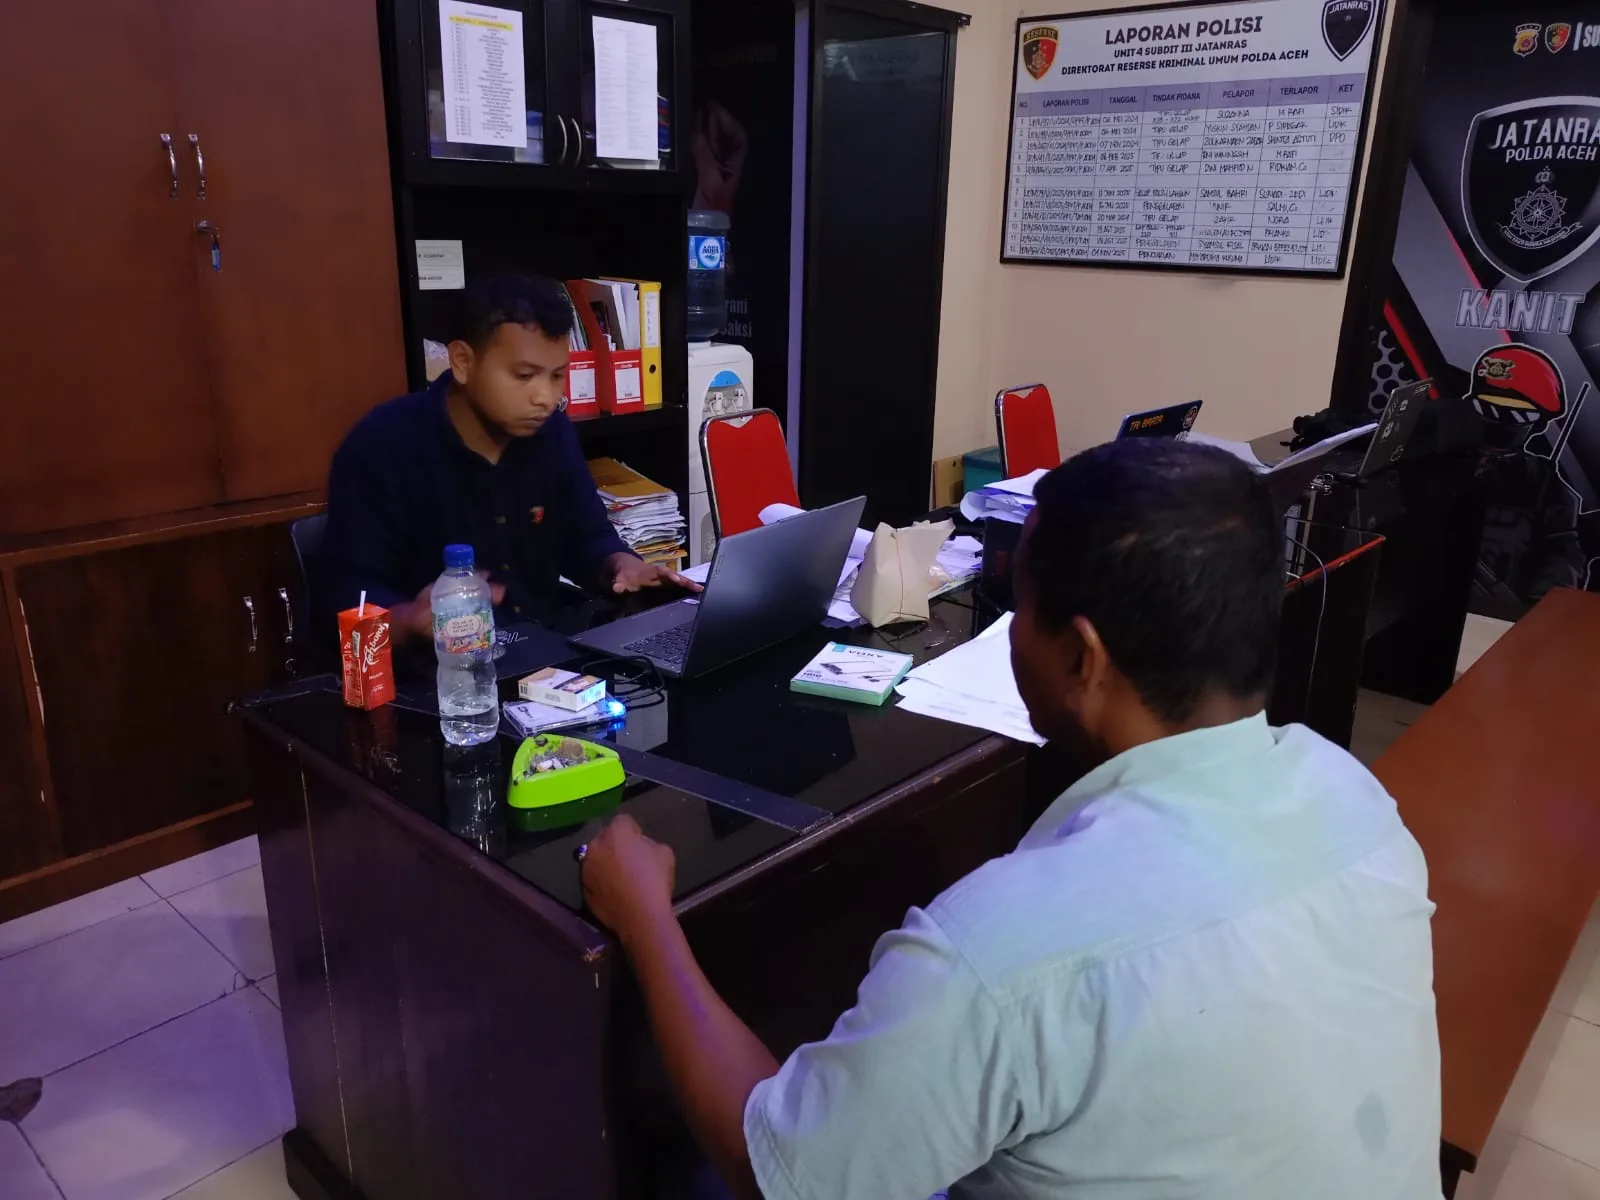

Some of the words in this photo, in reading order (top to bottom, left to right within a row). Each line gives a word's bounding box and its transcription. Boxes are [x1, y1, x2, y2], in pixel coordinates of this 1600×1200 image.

[1329, 0, 1368, 13] JATANRAS
[1105, 22, 1191, 45] LAPORAN
[1196, 16, 1263, 37] POLISI
[1145, 46, 1179, 56] SUBDIT
[1181, 44, 1193, 53] III
[1195, 39, 1247, 51] JATANRAS
[1061, 63, 1115, 76] DIREKTORAT
[1117, 61, 1156, 72] RESERSE
[1158, 57, 1206, 69] KRIMINAL
[1208, 55, 1239, 65] UMUM
[1241, 52, 1277, 63] POLDA
[1279, 49, 1309, 61] ACEH
[1223, 89, 1254, 98] PELAPOR
[1280, 86, 1318, 95] TERLAPOR
[1338, 84, 1354, 92] KET
[1109, 96, 1137, 104] TANGGAL
[1152, 93, 1175, 102] TINDAK
[1177, 92, 1200, 101] PIDANA
[1043, 100, 1070, 108] LAPORAN
[1506, 146, 1552, 163] POLDA
[1556, 145, 1597, 161] ACEH
[1456, 288, 1586, 334] KANIT
